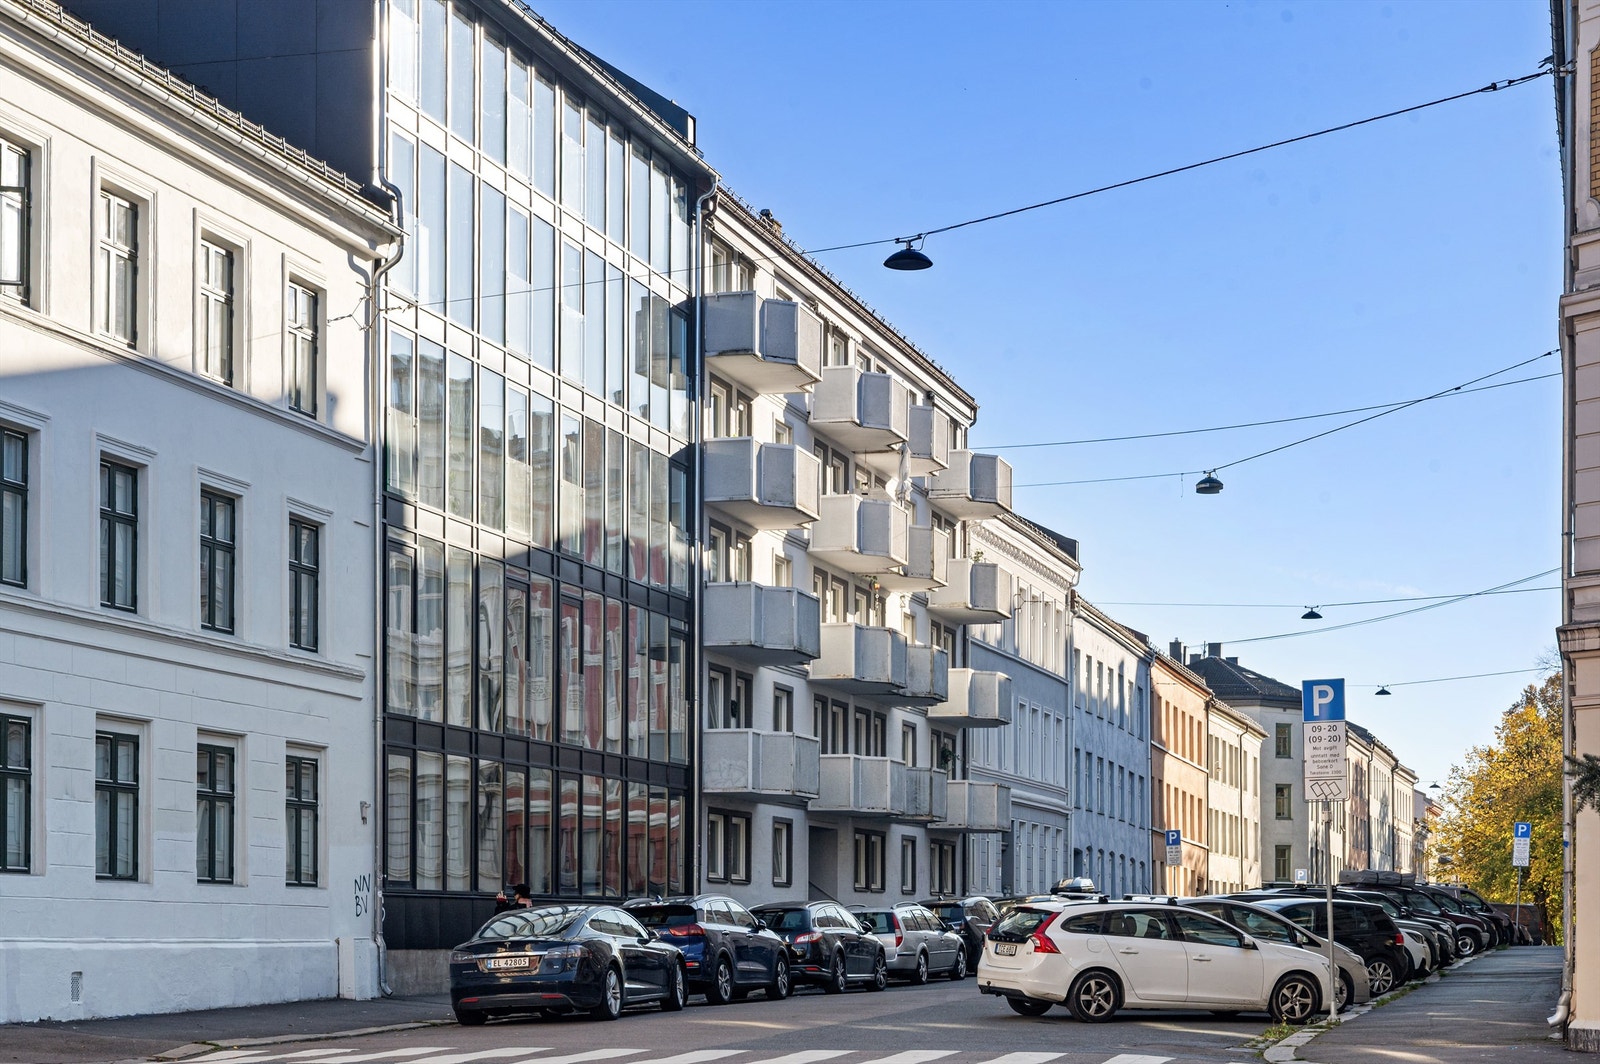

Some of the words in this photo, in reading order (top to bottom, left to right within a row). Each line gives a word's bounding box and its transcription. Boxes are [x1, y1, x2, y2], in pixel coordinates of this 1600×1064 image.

[1313, 684, 1334, 716] P
[1518, 824, 1527, 836] P
[1169, 832, 1177, 844] P
[1297, 870, 1304, 880] P
[504, 959, 527, 967] 42805
